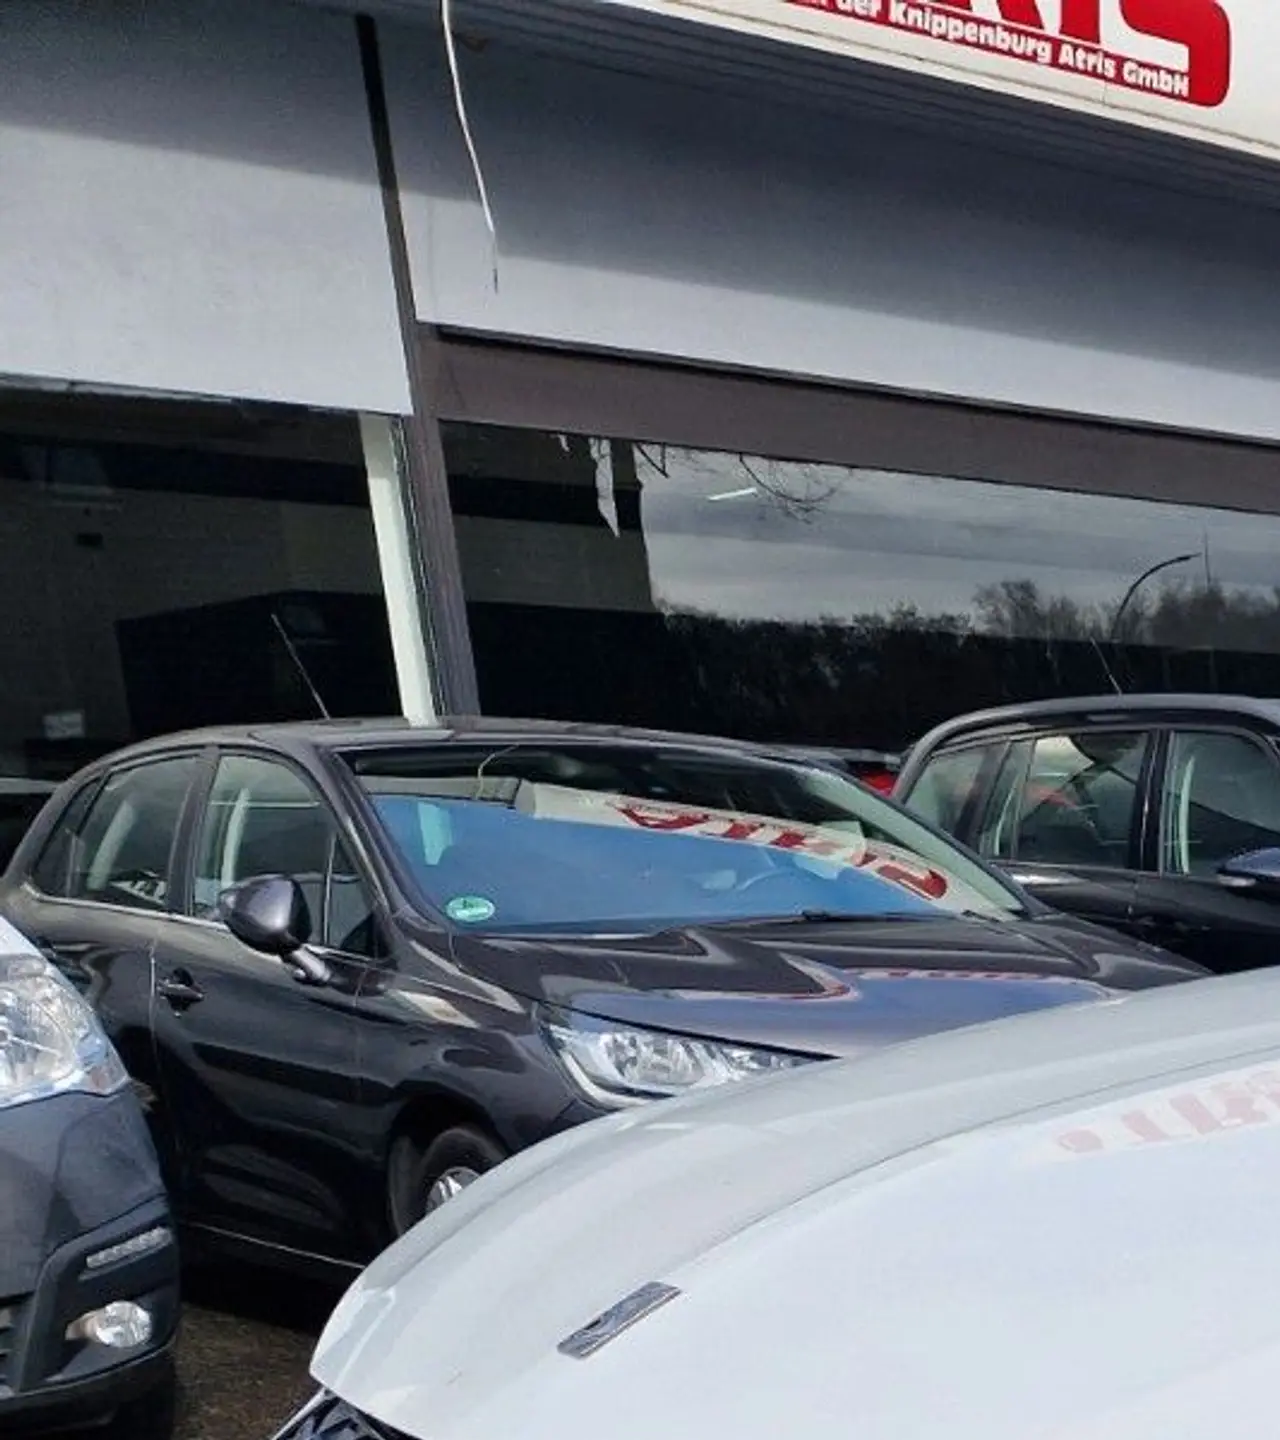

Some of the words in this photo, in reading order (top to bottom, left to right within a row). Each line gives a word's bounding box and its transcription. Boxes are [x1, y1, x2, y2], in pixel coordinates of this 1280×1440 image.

[889, 0, 1051, 62] Knippenburg
[1058, 44, 1116, 78] Atris
[1123, 61, 1190, 97] GmbH
